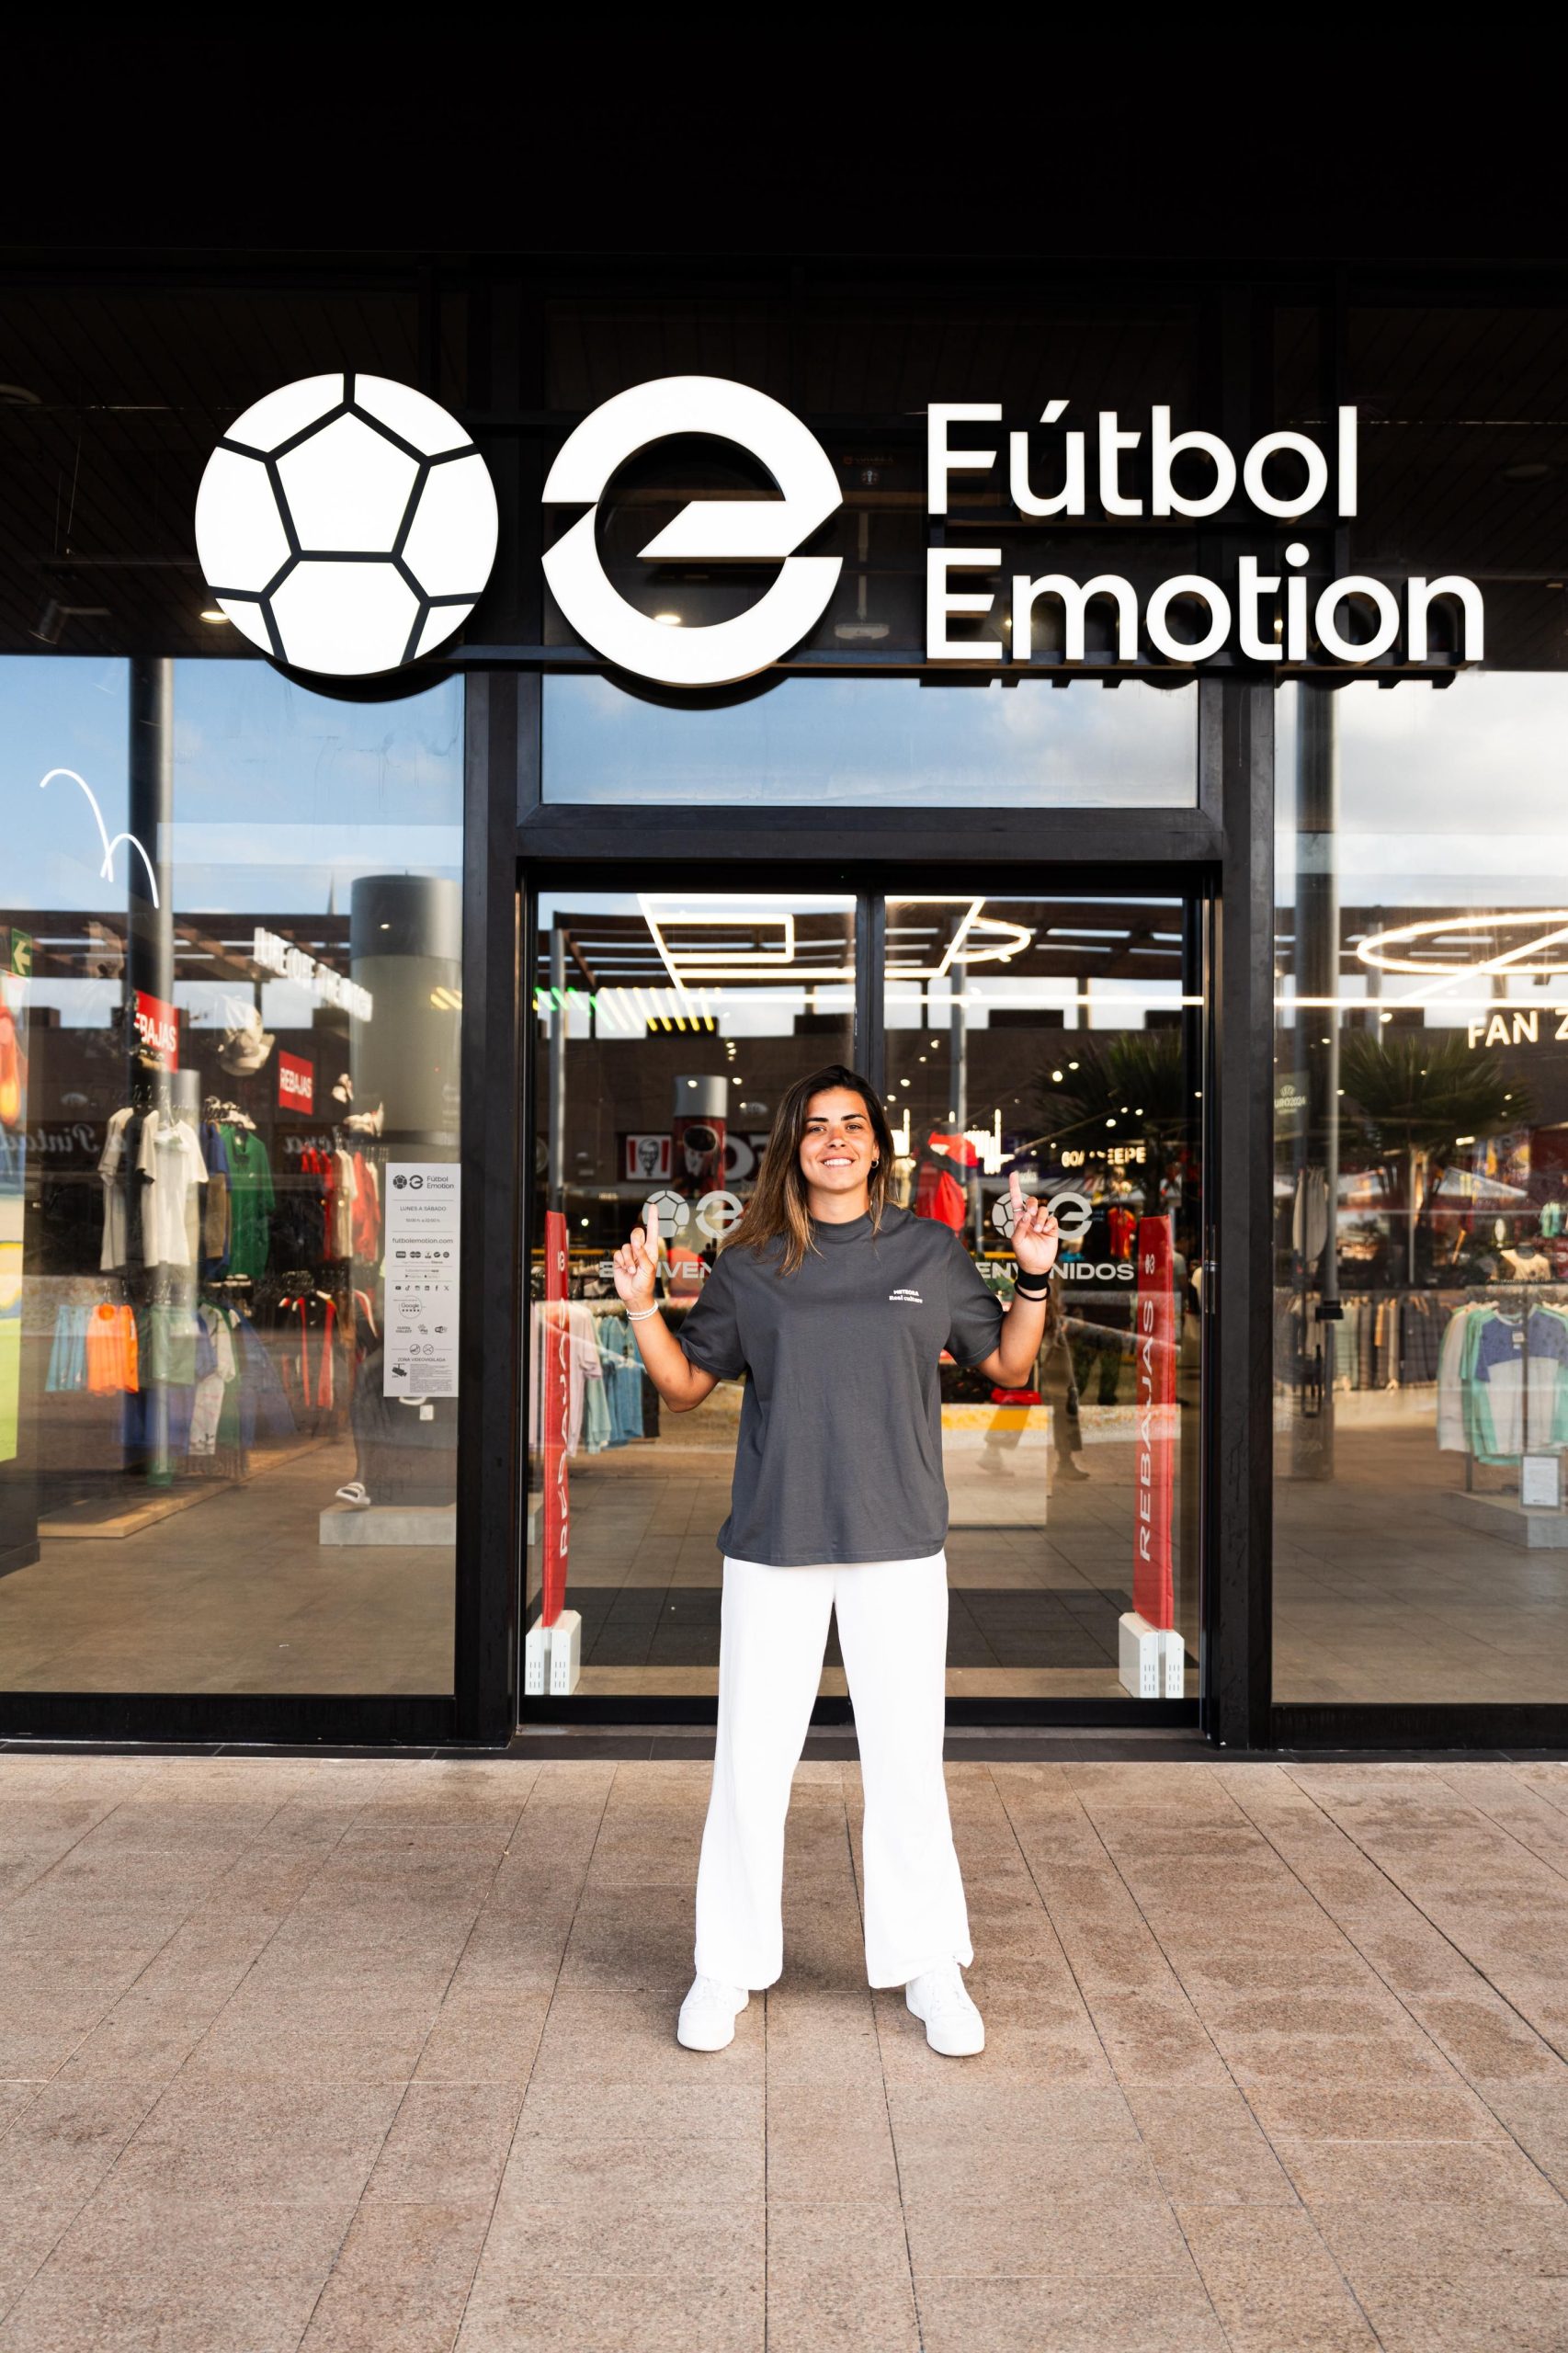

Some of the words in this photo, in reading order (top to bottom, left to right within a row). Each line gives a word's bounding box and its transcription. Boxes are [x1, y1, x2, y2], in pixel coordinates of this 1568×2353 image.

[927, 400, 1358, 517] Fútbol
[926, 542, 1484, 663] Emotion
[1468, 1010, 1539, 1049] FAN
[279, 1067, 312, 1098] REBAJAS
[426, 1175, 449, 1183] Fútbol
[1140, 1300, 1153, 1561] REBAJAS
